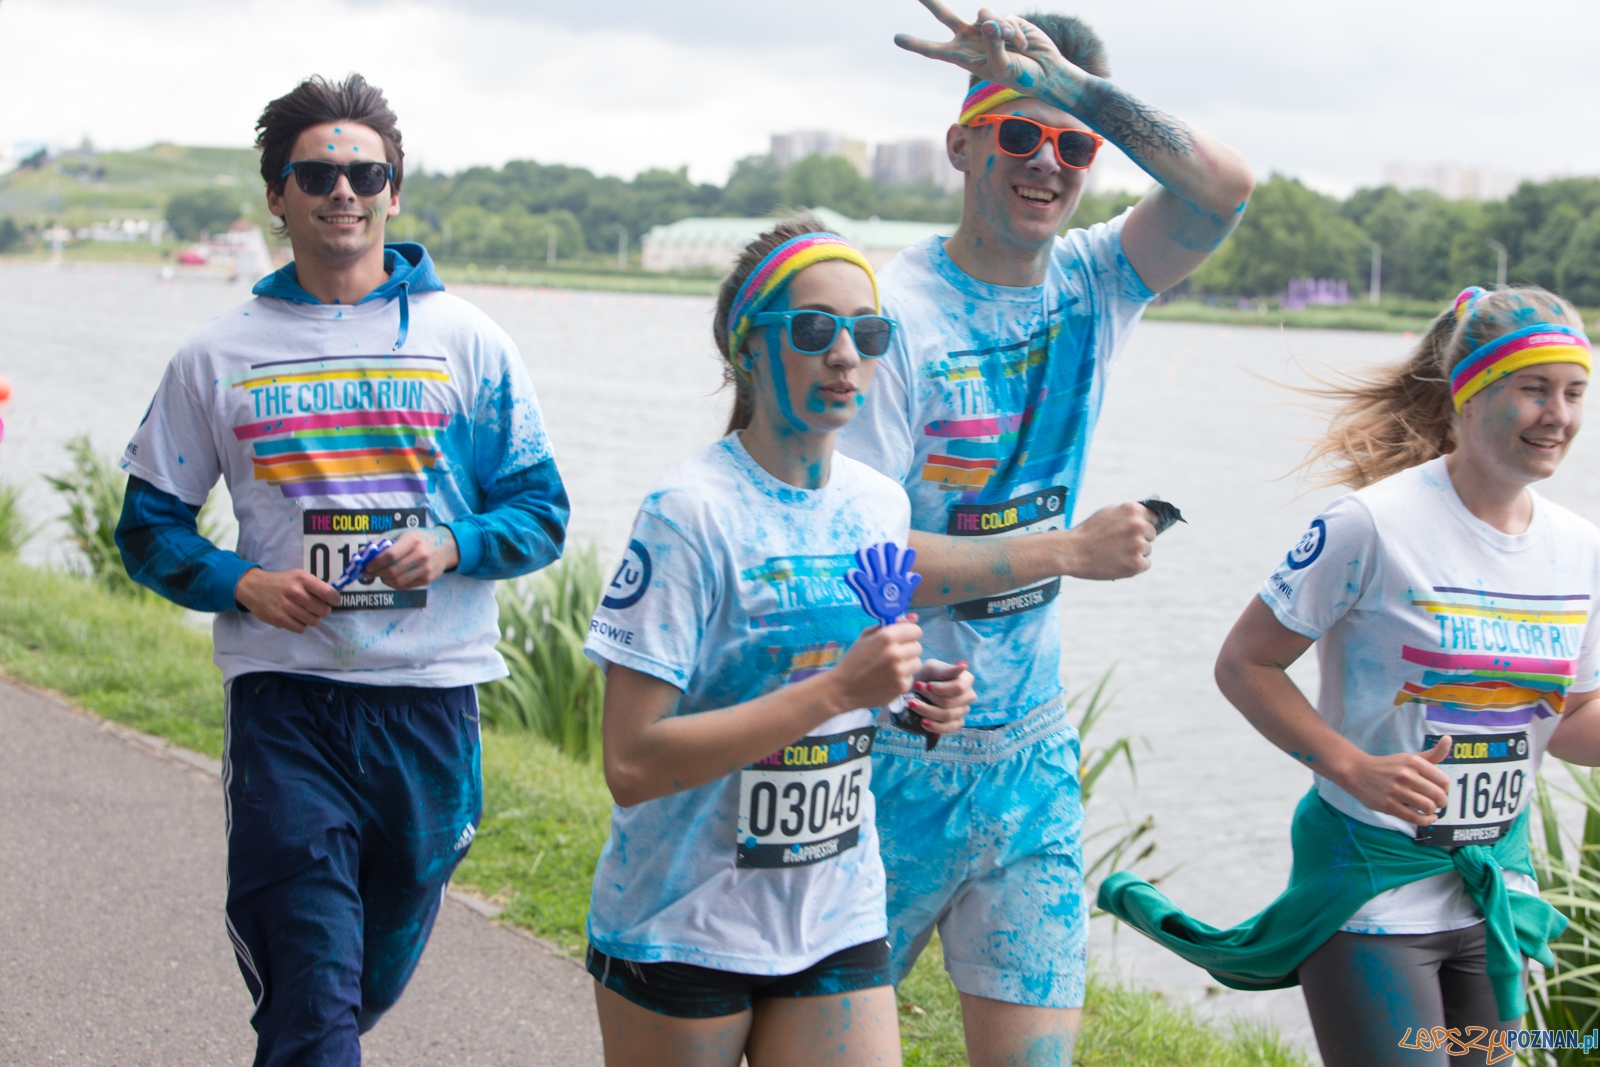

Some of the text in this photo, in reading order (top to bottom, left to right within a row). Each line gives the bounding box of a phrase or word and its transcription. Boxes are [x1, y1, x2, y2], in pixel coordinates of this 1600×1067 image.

[251, 380, 423, 418] THE COLOR RUN
[311, 514, 393, 531] THE COLOR RUN
[957, 513, 981, 531] THE
[981, 507, 1018, 530] COLOR
[1435, 614, 1478, 651] THE
[1480, 619, 1547, 657] COLOR
[783, 744, 830, 766] COLOR
[1453, 742, 1489, 759] COLOR
[1489, 741, 1509, 759] RUN
[749, 768, 863, 837] 03045
[1437, 769, 1523, 819] 1649
